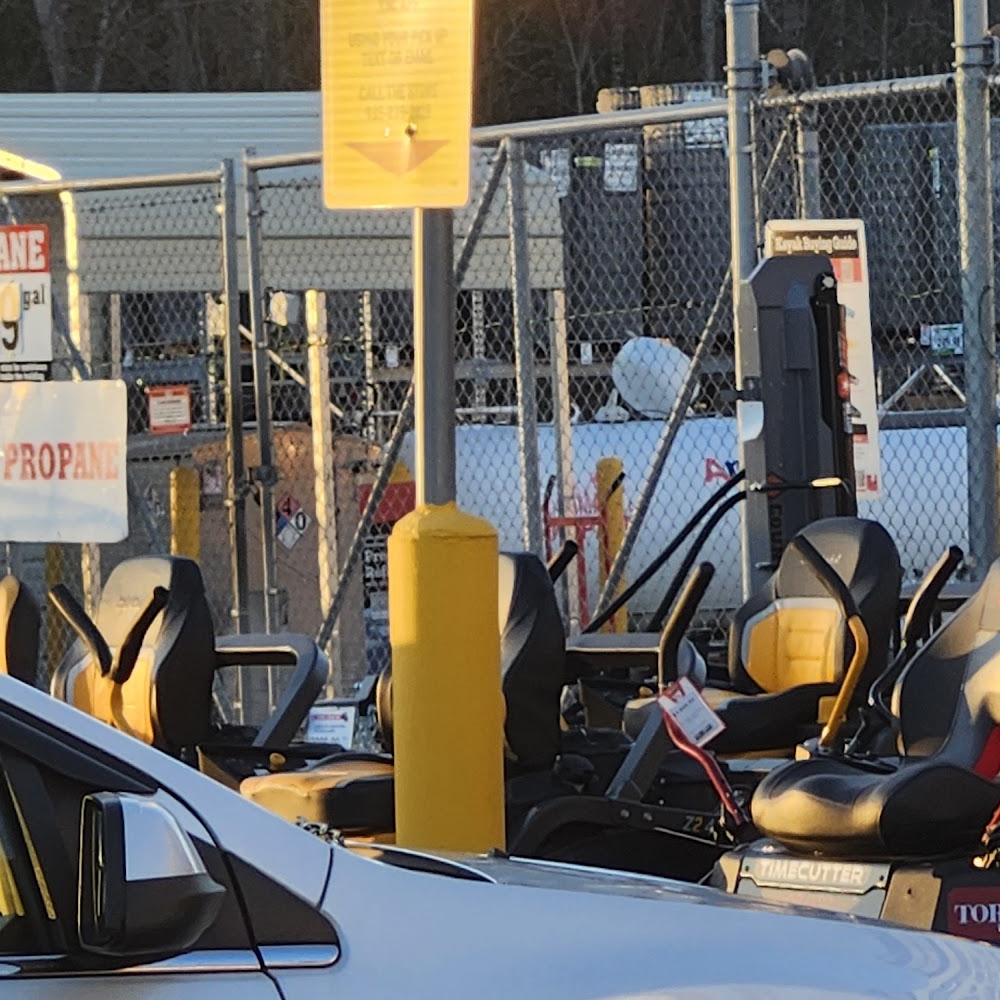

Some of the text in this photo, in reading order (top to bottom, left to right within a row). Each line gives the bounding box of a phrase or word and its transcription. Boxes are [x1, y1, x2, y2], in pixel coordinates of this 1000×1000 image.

[23, 284, 45, 310] gal
[4, 442, 119, 480] PROPANE
[295, 511, 307, 530] 0
[759, 860, 865, 884] TIMECUTTER
